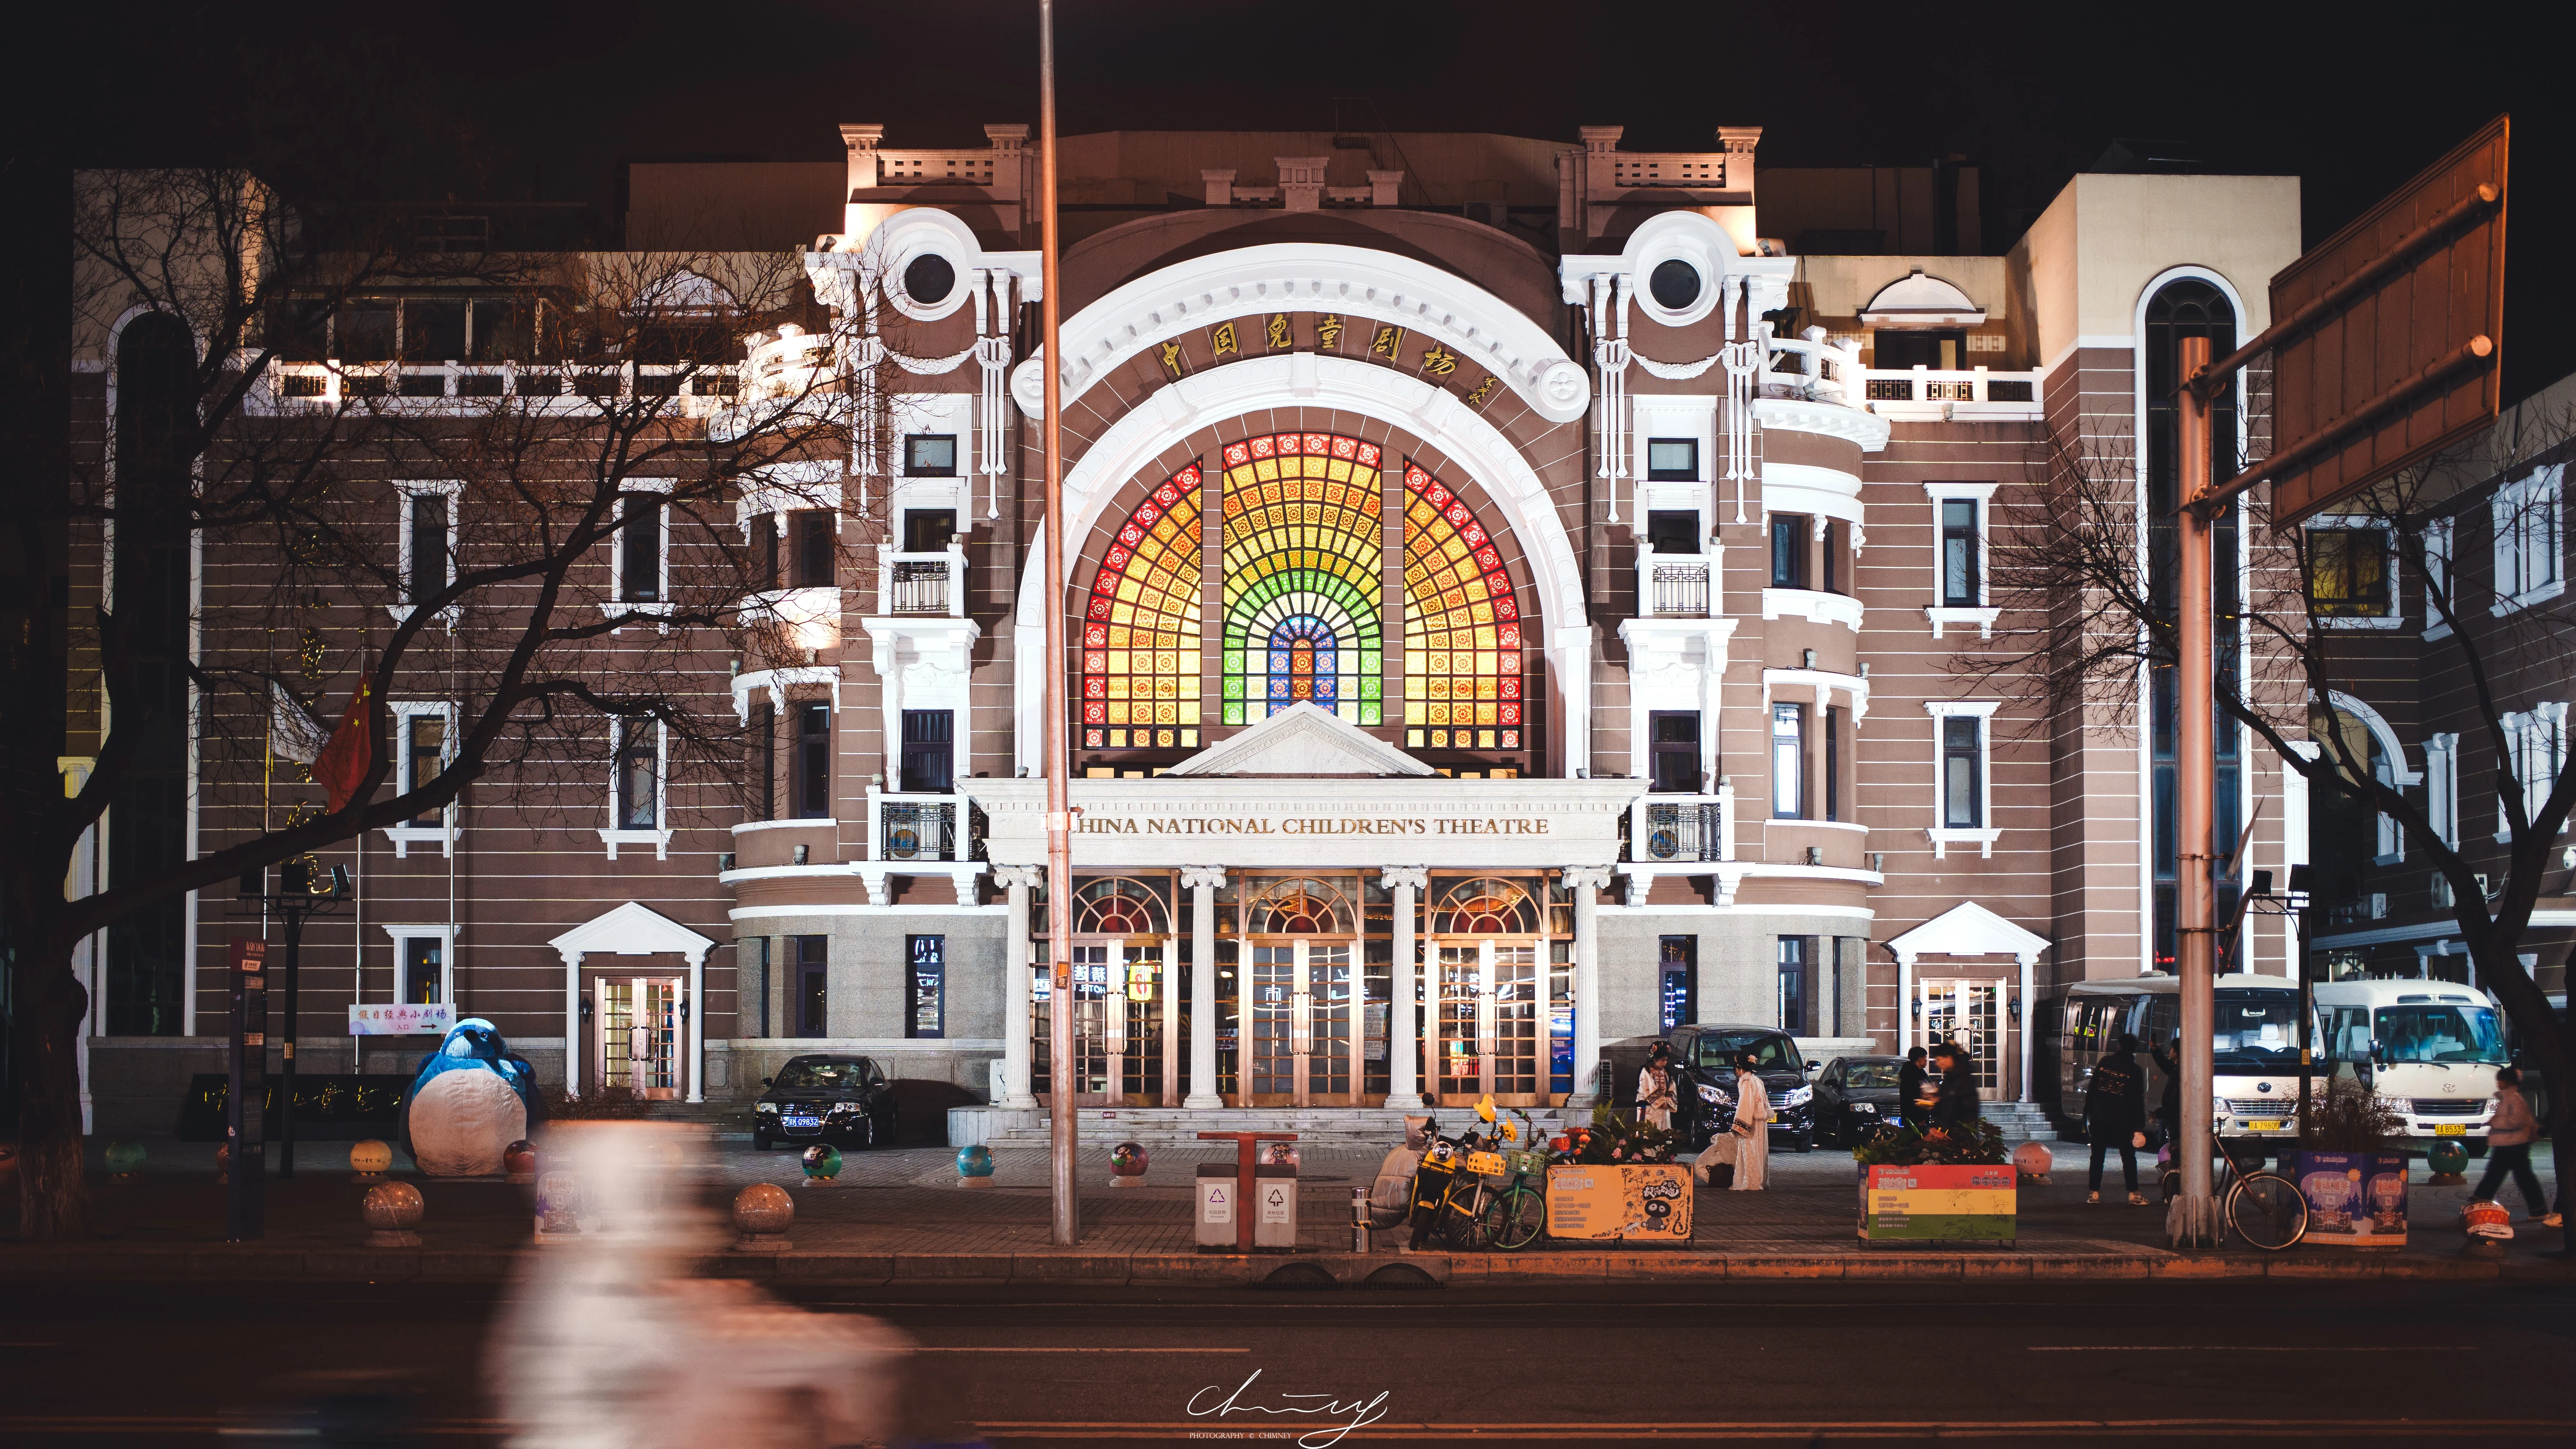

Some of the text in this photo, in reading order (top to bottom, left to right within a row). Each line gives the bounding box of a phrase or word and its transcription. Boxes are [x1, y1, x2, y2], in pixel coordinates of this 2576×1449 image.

[1071, 818, 1549, 834] HINA NATIONAL CHILDREN'S THEATRE
[358, 1009, 447, 1020] 假日经典小剧场
